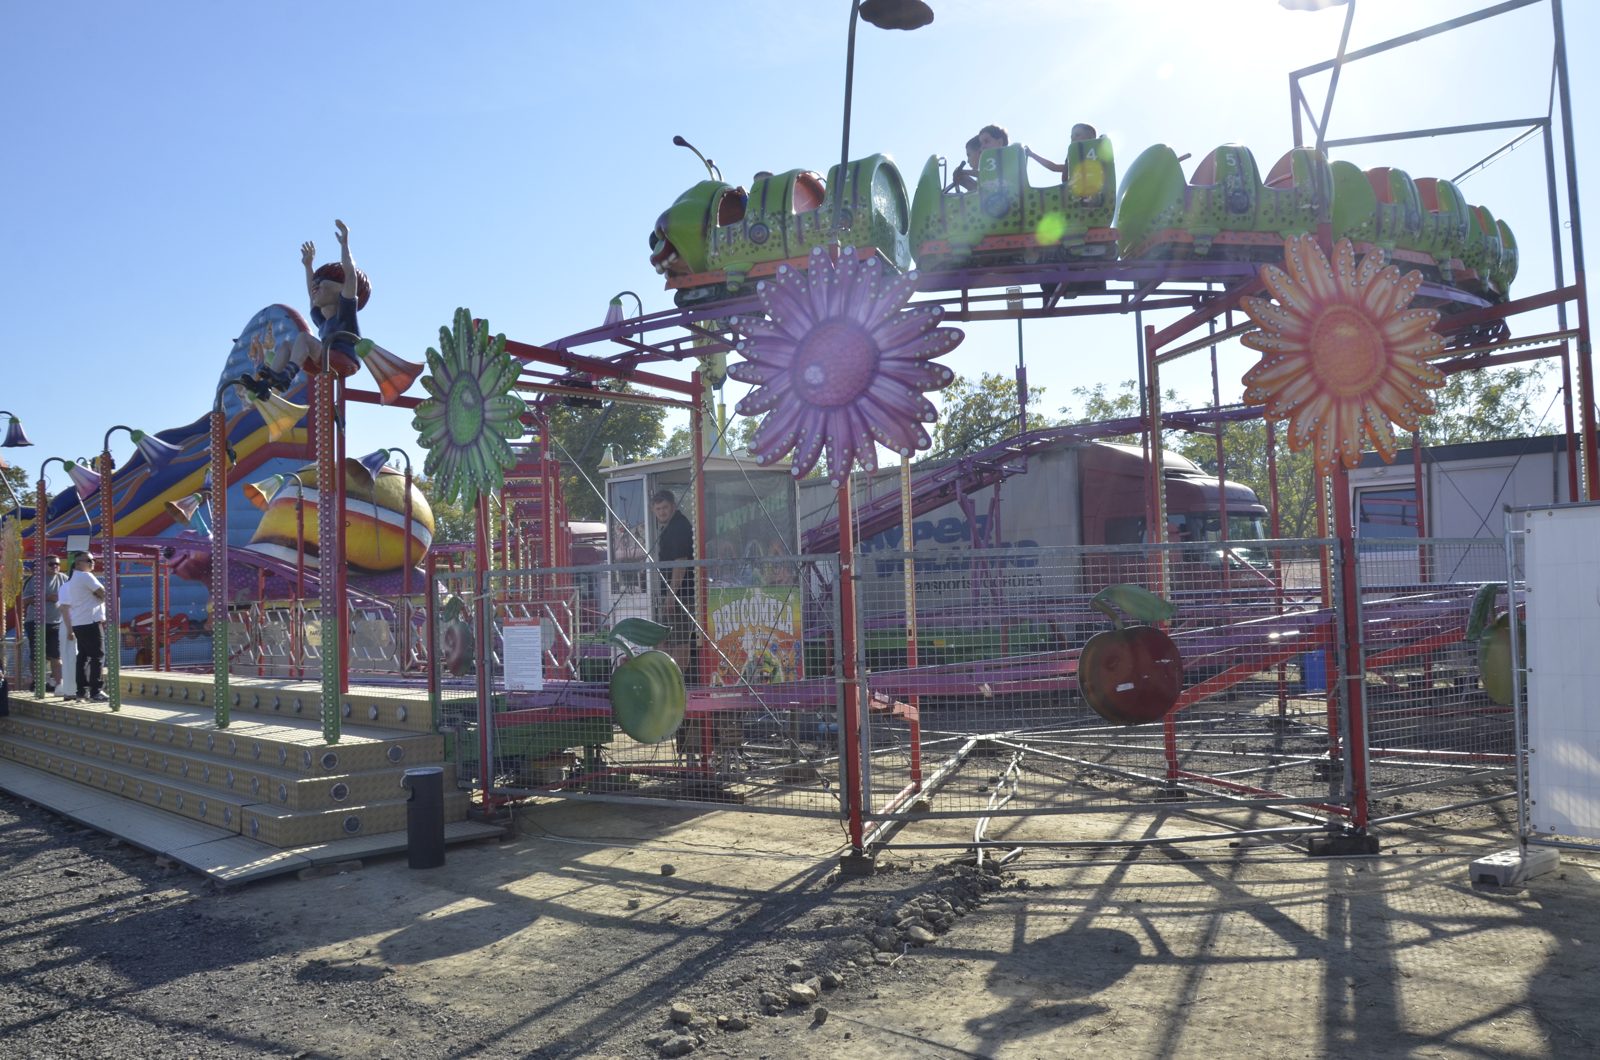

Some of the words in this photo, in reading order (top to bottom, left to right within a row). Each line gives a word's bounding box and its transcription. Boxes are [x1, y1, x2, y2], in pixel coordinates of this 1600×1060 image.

[1086, 148, 1096, 161] 4
[1226, 153, 1236, 167] 5
[985, 157, 997, 172] 3
[712, 596, 794, 641] BRUCOMELA
